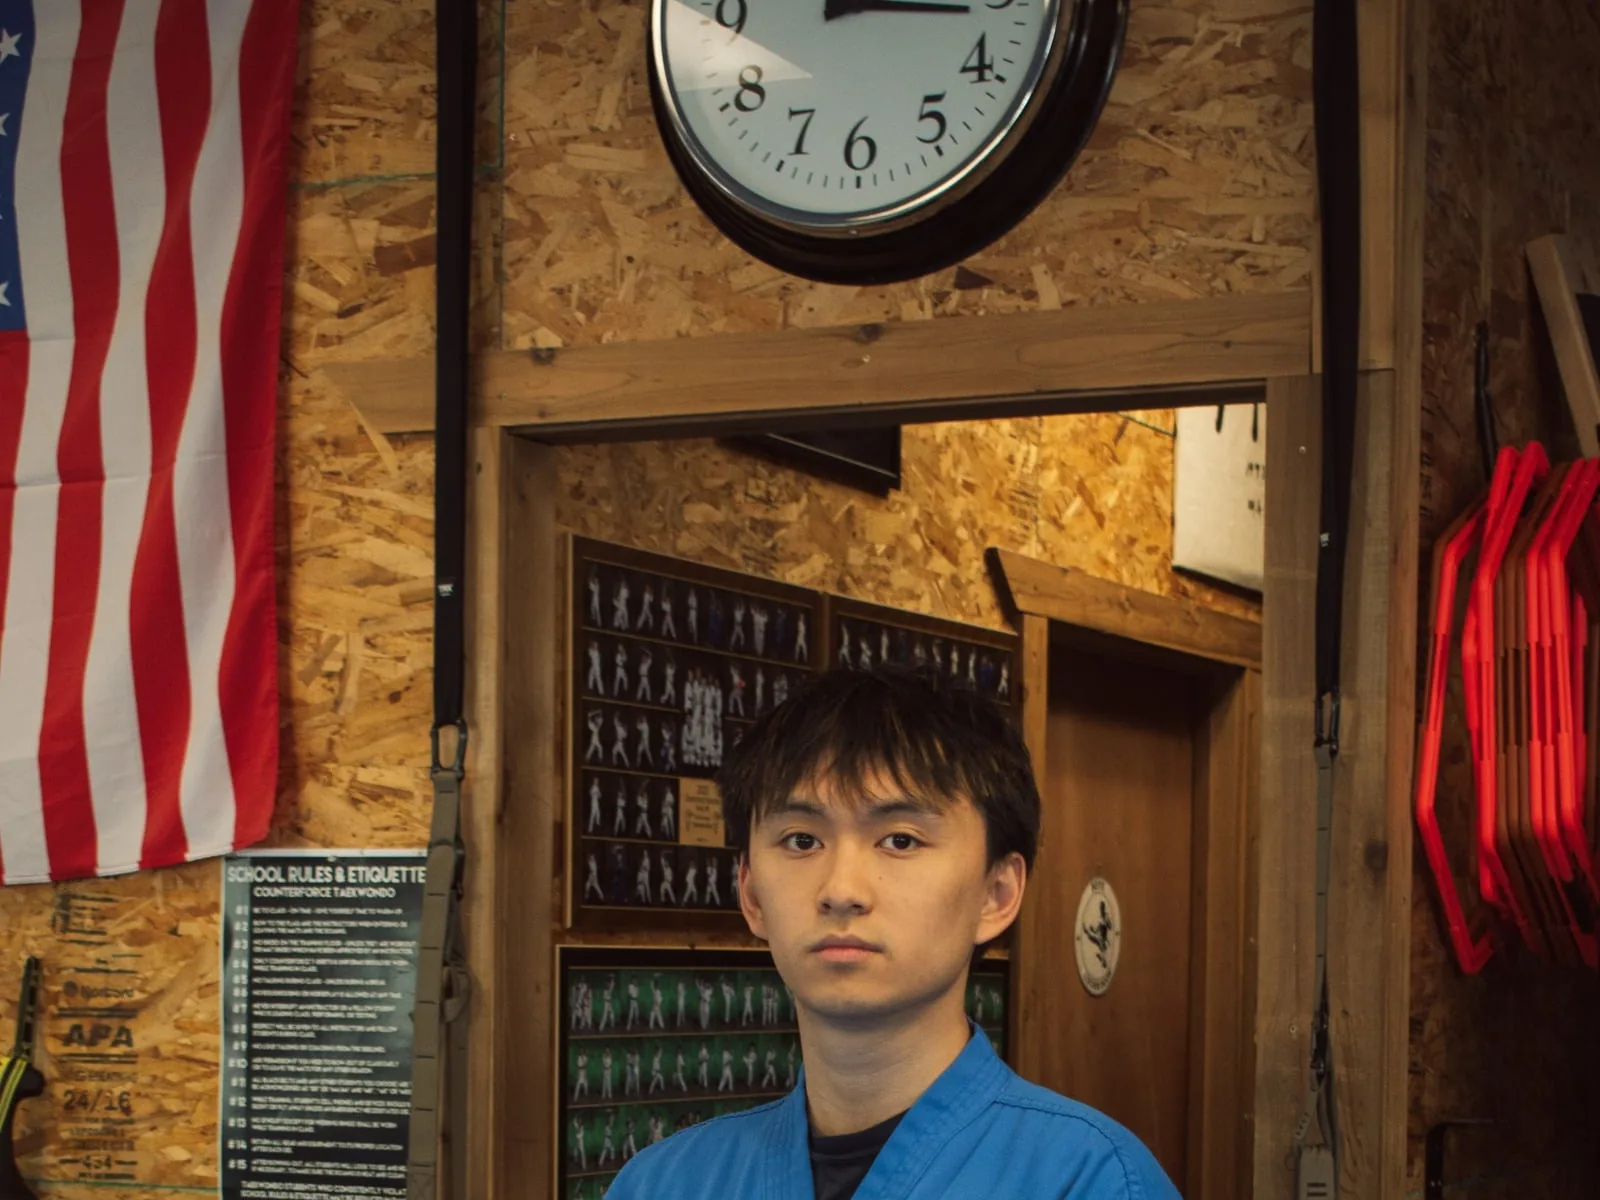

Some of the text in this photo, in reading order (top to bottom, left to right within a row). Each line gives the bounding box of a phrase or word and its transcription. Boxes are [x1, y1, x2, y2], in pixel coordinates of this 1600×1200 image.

[714, 0, 748, 46] 9
[959, 31, 994, 85] 4
[733, 64, 767, 113] 8
[787, 107, 817, 156] 7
[916, 90, 948, 144] 5
[843, 115, 878, 171] 6
[228, 866, 426, 883] SCHOOL RULES & ETIQUETTE
[253, 886, 396, 898] COUNTERFORCE TAEKWONDO
[62, 1024, 133, 1048] APA
[63, 1088, 132, 1112] 24/16
